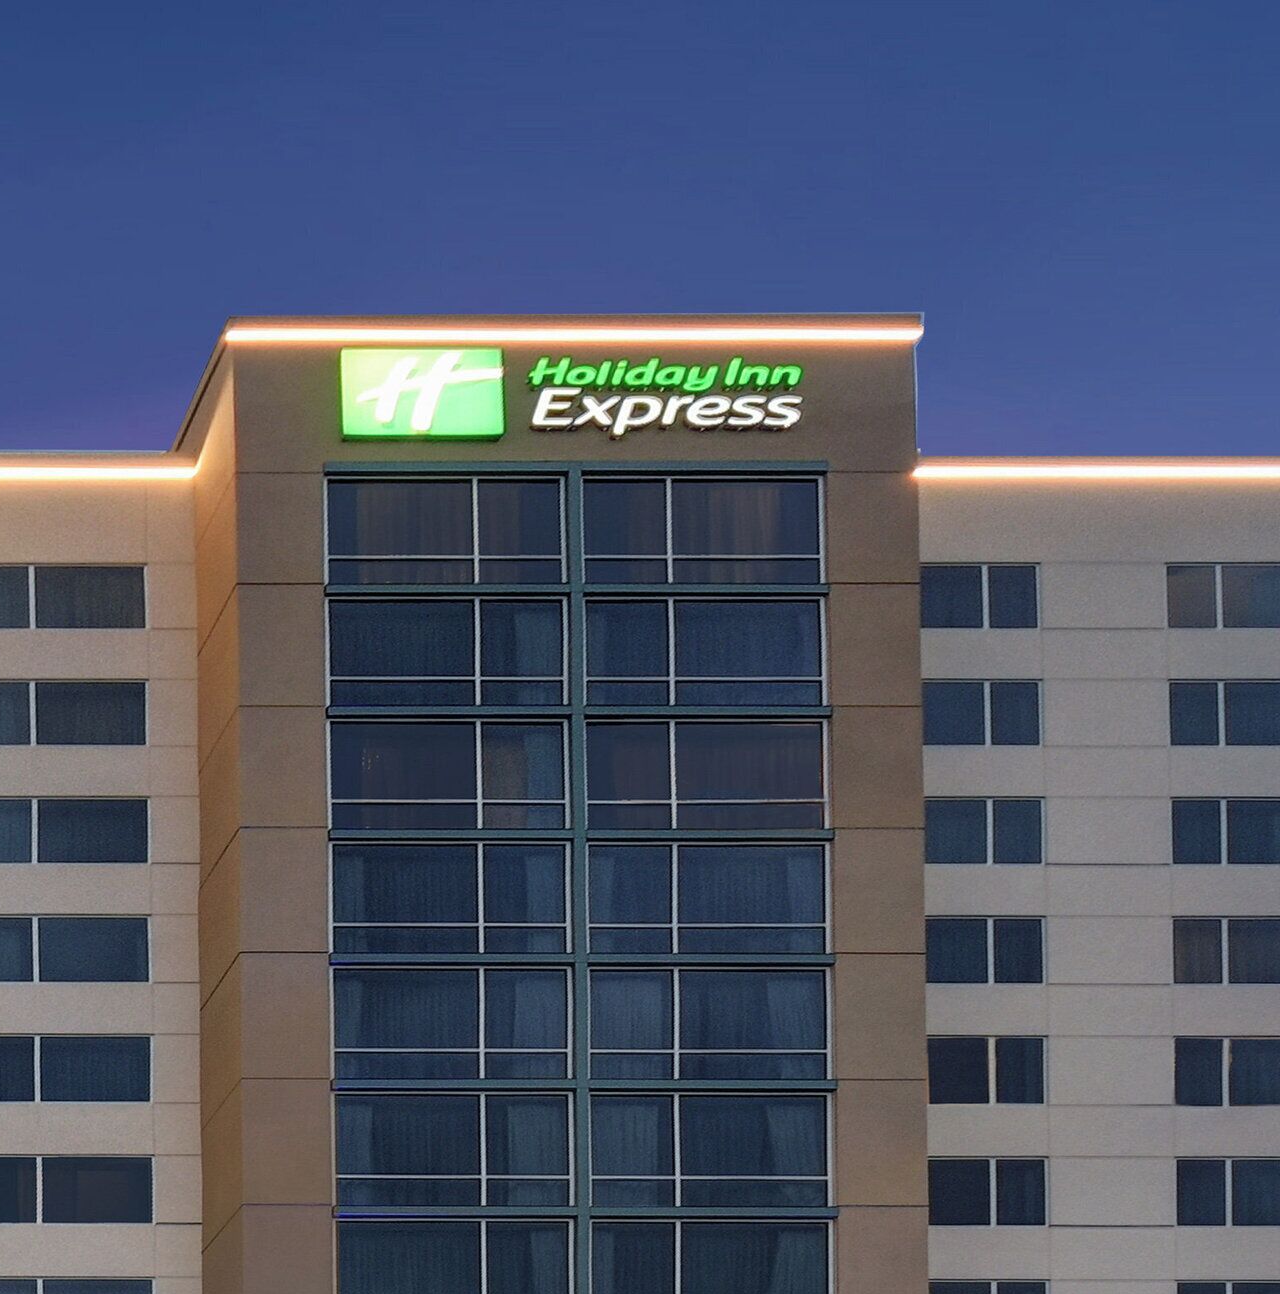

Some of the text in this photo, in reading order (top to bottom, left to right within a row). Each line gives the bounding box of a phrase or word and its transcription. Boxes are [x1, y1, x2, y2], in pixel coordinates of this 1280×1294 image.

[529, 356, 803, 392] Holiday Inn
[532, 387, 803, 439] Express
